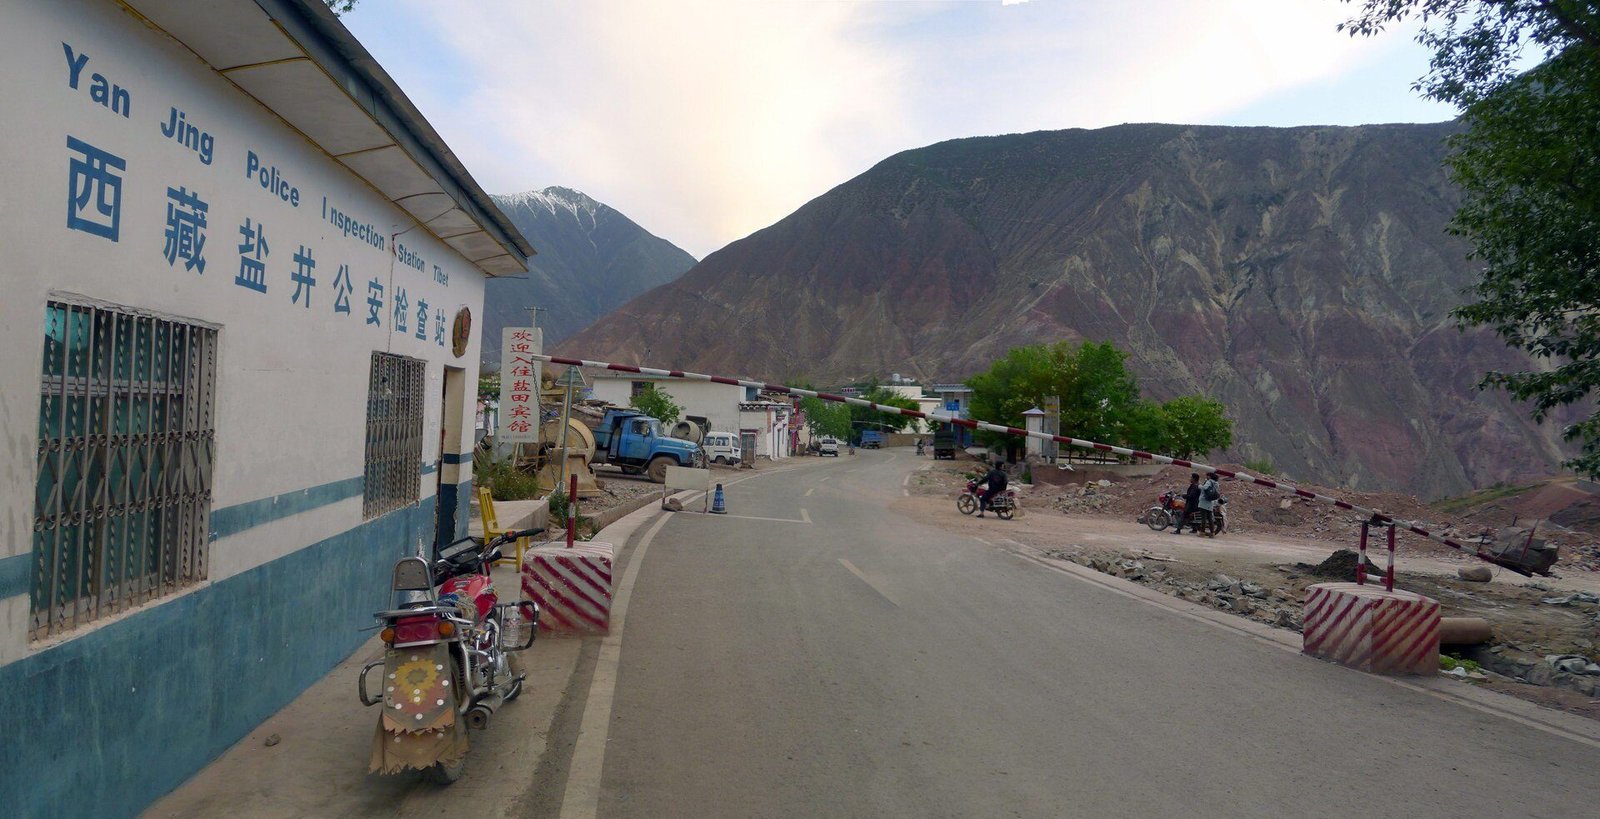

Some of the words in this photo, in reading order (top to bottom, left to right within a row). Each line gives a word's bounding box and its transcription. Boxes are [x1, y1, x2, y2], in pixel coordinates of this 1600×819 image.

[61, 41, 131, 119] Yan
[160, 106, 214, 166] Jing
[246, 150, 300, 208] Police
[398, 243, 425, 274] Station
[433, 264, 449, 288] Tibet
[66, 135, 446, 348] 西藏盐井公安检查站
[507, 329, 534, 433] 欢迎入住盐田宾馆
